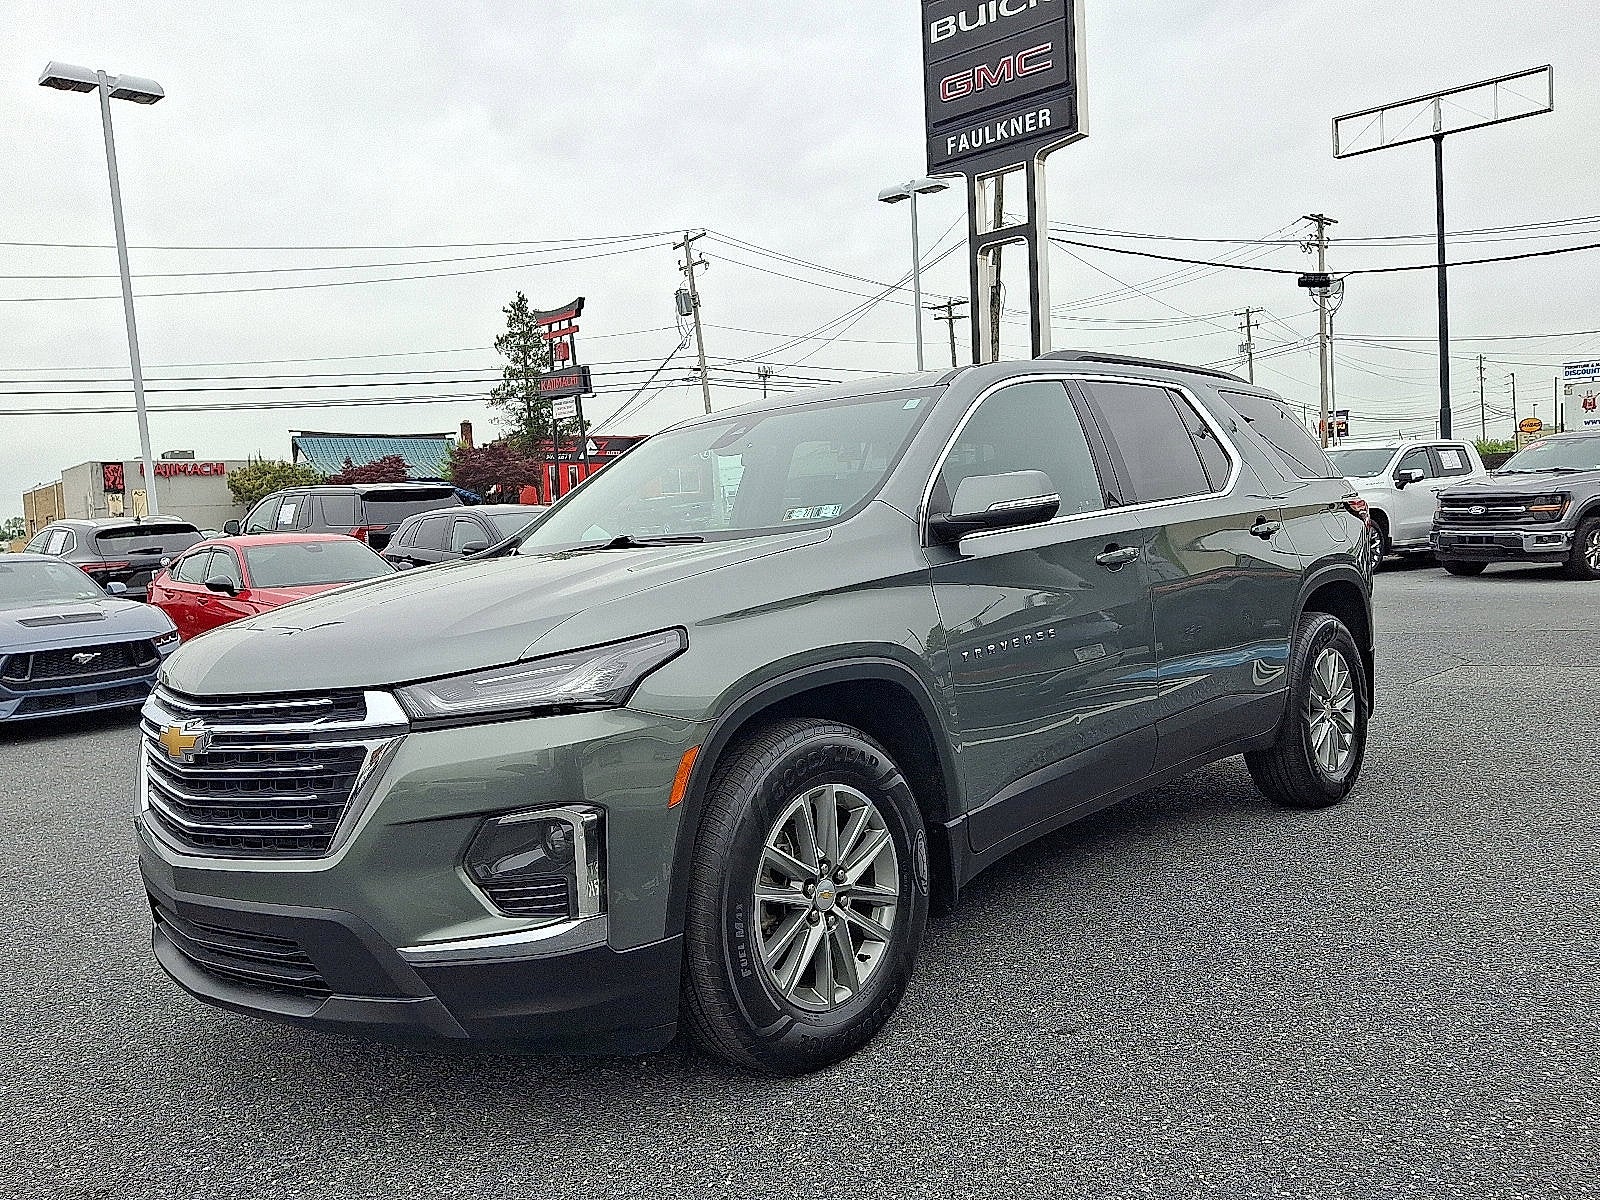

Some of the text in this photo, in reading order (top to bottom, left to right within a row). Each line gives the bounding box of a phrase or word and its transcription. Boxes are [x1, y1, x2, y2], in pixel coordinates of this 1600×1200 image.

[930, 0, 1052, 43] BUIC
[940, 42, 1053, 101] GMC
[947, 108, 1051, 155] FAULKNER
[140, 462, 225, 479] AJIMACHI
[961, 628, 1056, 662] TRAVERSE
